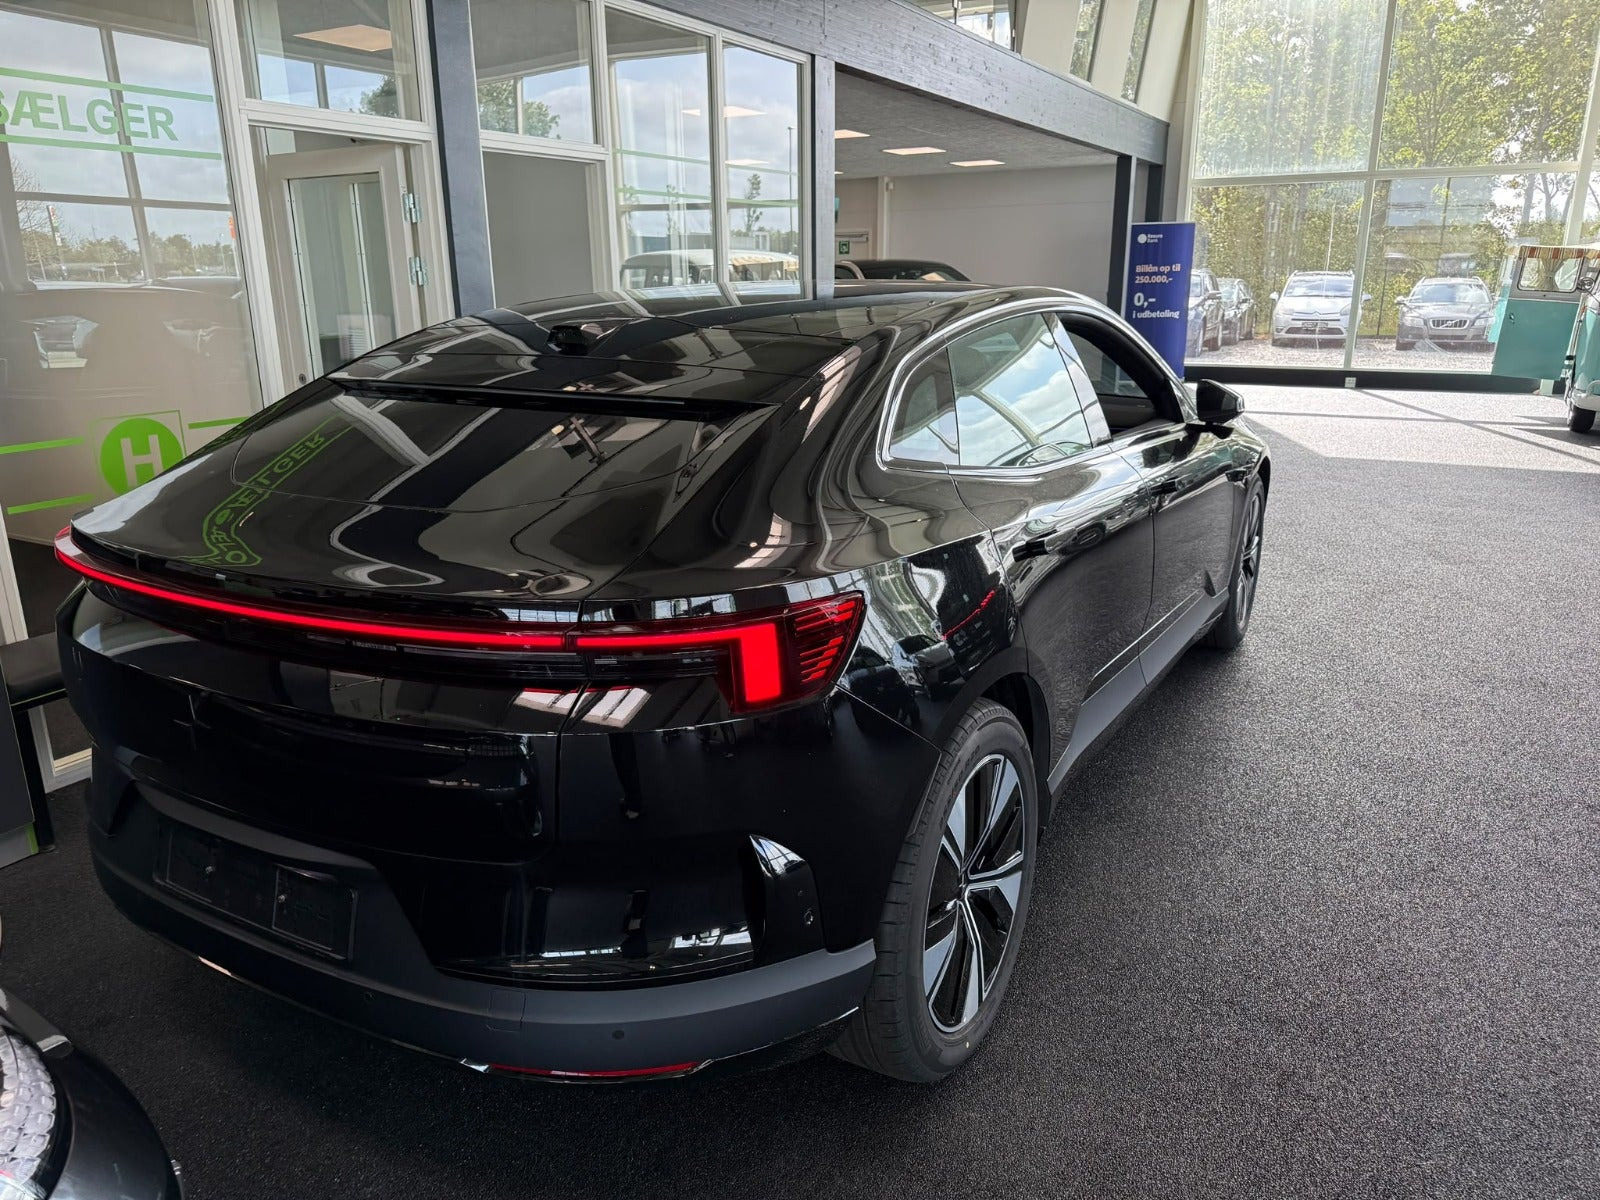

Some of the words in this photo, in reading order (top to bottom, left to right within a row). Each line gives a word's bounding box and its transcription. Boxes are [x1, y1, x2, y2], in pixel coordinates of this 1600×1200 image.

[1135, 264, 1158, 273] Billån
[1159, 265, 1171, 274] op
[1172, 263, 1181, 272] til
[1135, 275, 1173, 284] 250.000,-
[1133, 292, 1156, 308] 0,-
[1136, 310, 1180, 319] udbetaling
